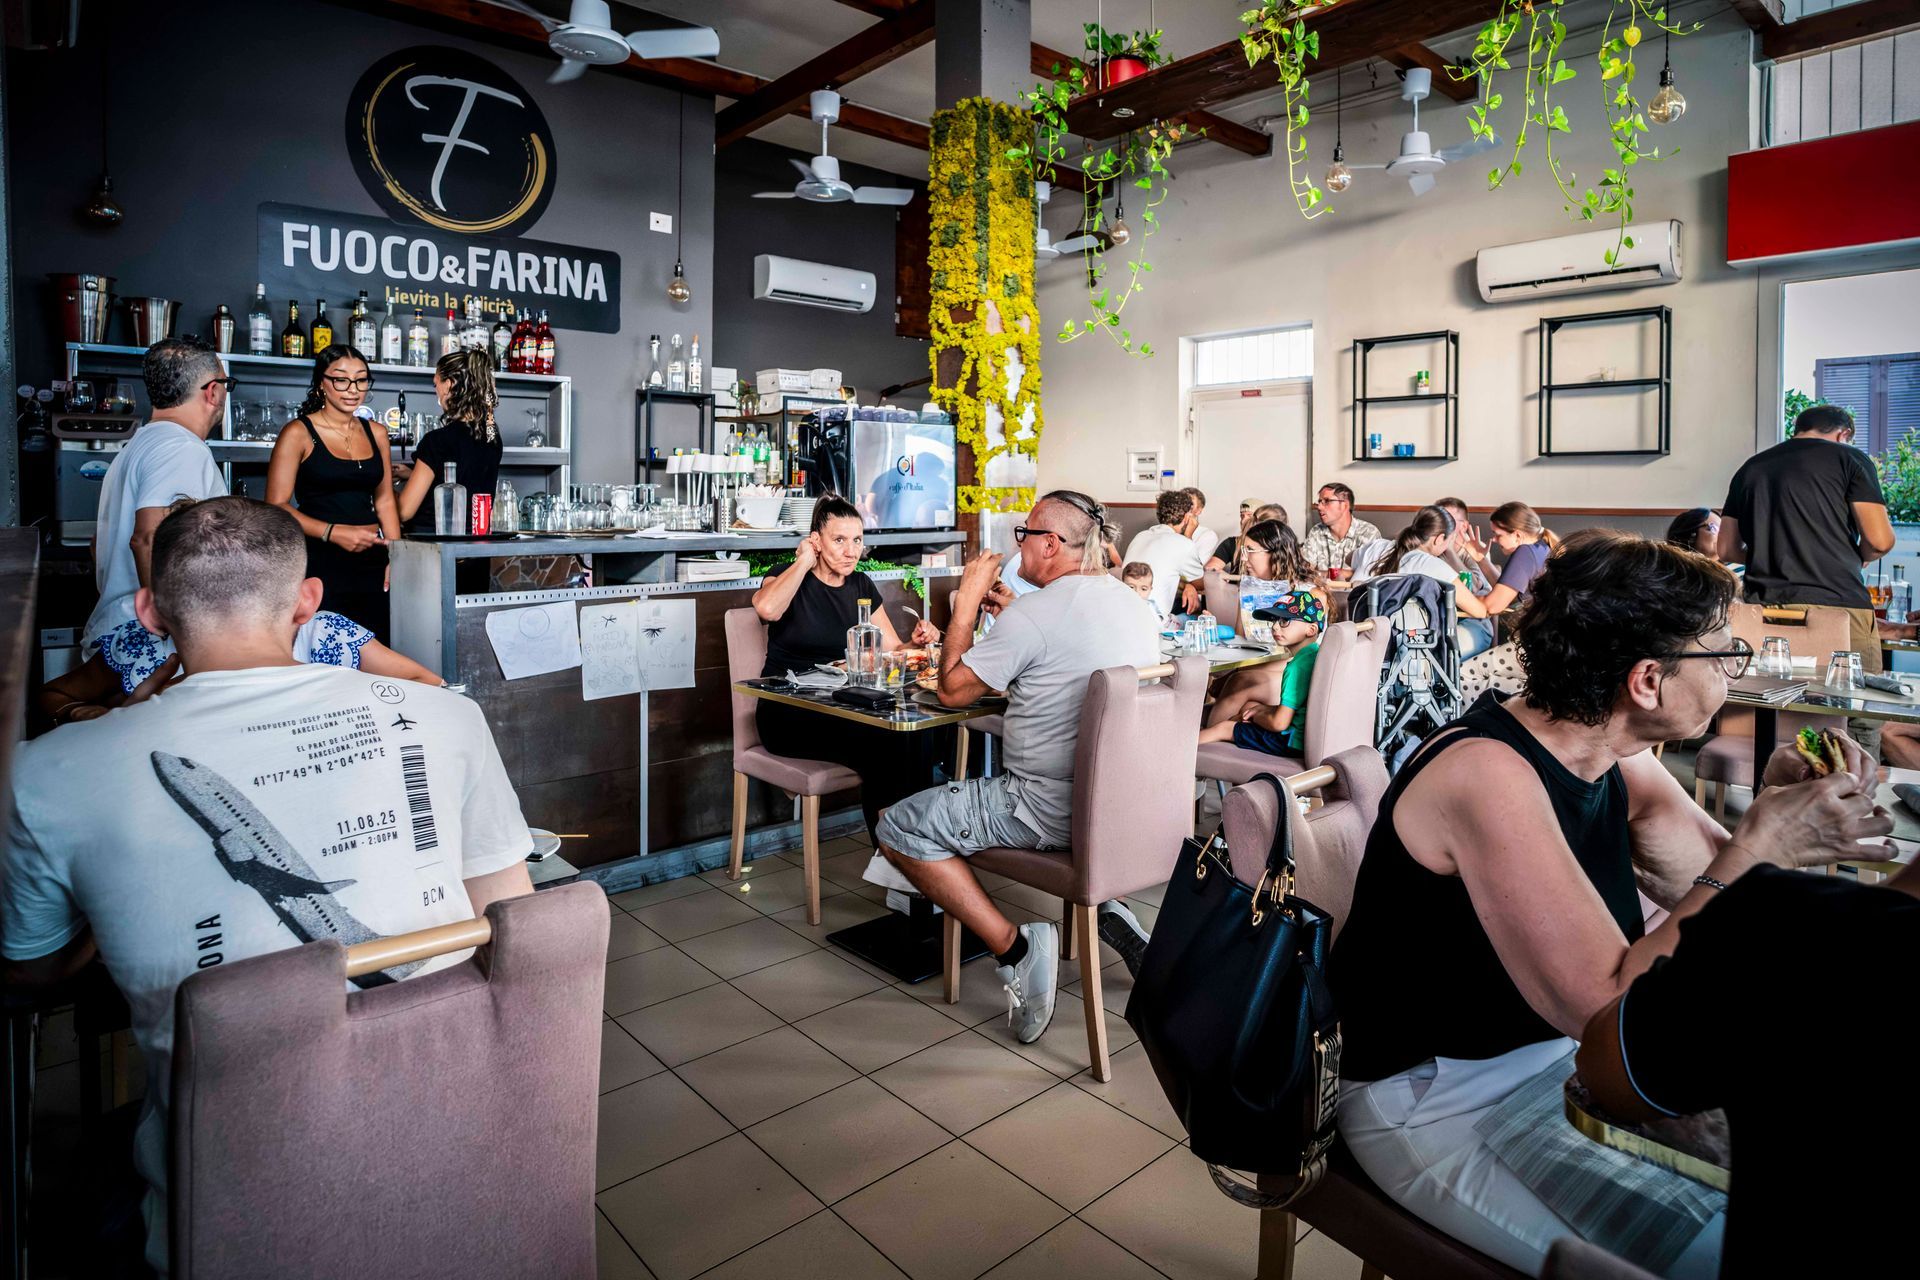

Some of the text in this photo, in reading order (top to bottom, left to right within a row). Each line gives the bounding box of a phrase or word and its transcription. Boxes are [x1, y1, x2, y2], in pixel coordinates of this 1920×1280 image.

[405, 75, 525, 212] F
[282, 221, 608, 302] FUOCO&FARINA
[444, 291, 458, 310] la
[376, 684, 399, 698] 20
[247, 719, 297, 733] AEROPUERTO
[323, 705, 370, 721] TARRADELLAS
[291, 721, 339, 736] BARCELLONA
[357, 713, 373, 721] PRAT
[355, 721, 376, 730] 08820
[296, 729, 379, 753] EL PRAT DE LLOBREGAT
[308, 736, 382, 760] BARCELONA, ESPAÑA
[337, 810, 396, 835] 11.08.25
[321, 840, 357, 857] 9:00AM
[368, 831, 398, 845] 2:00PM
[423, 885, 444, 906] BCN
